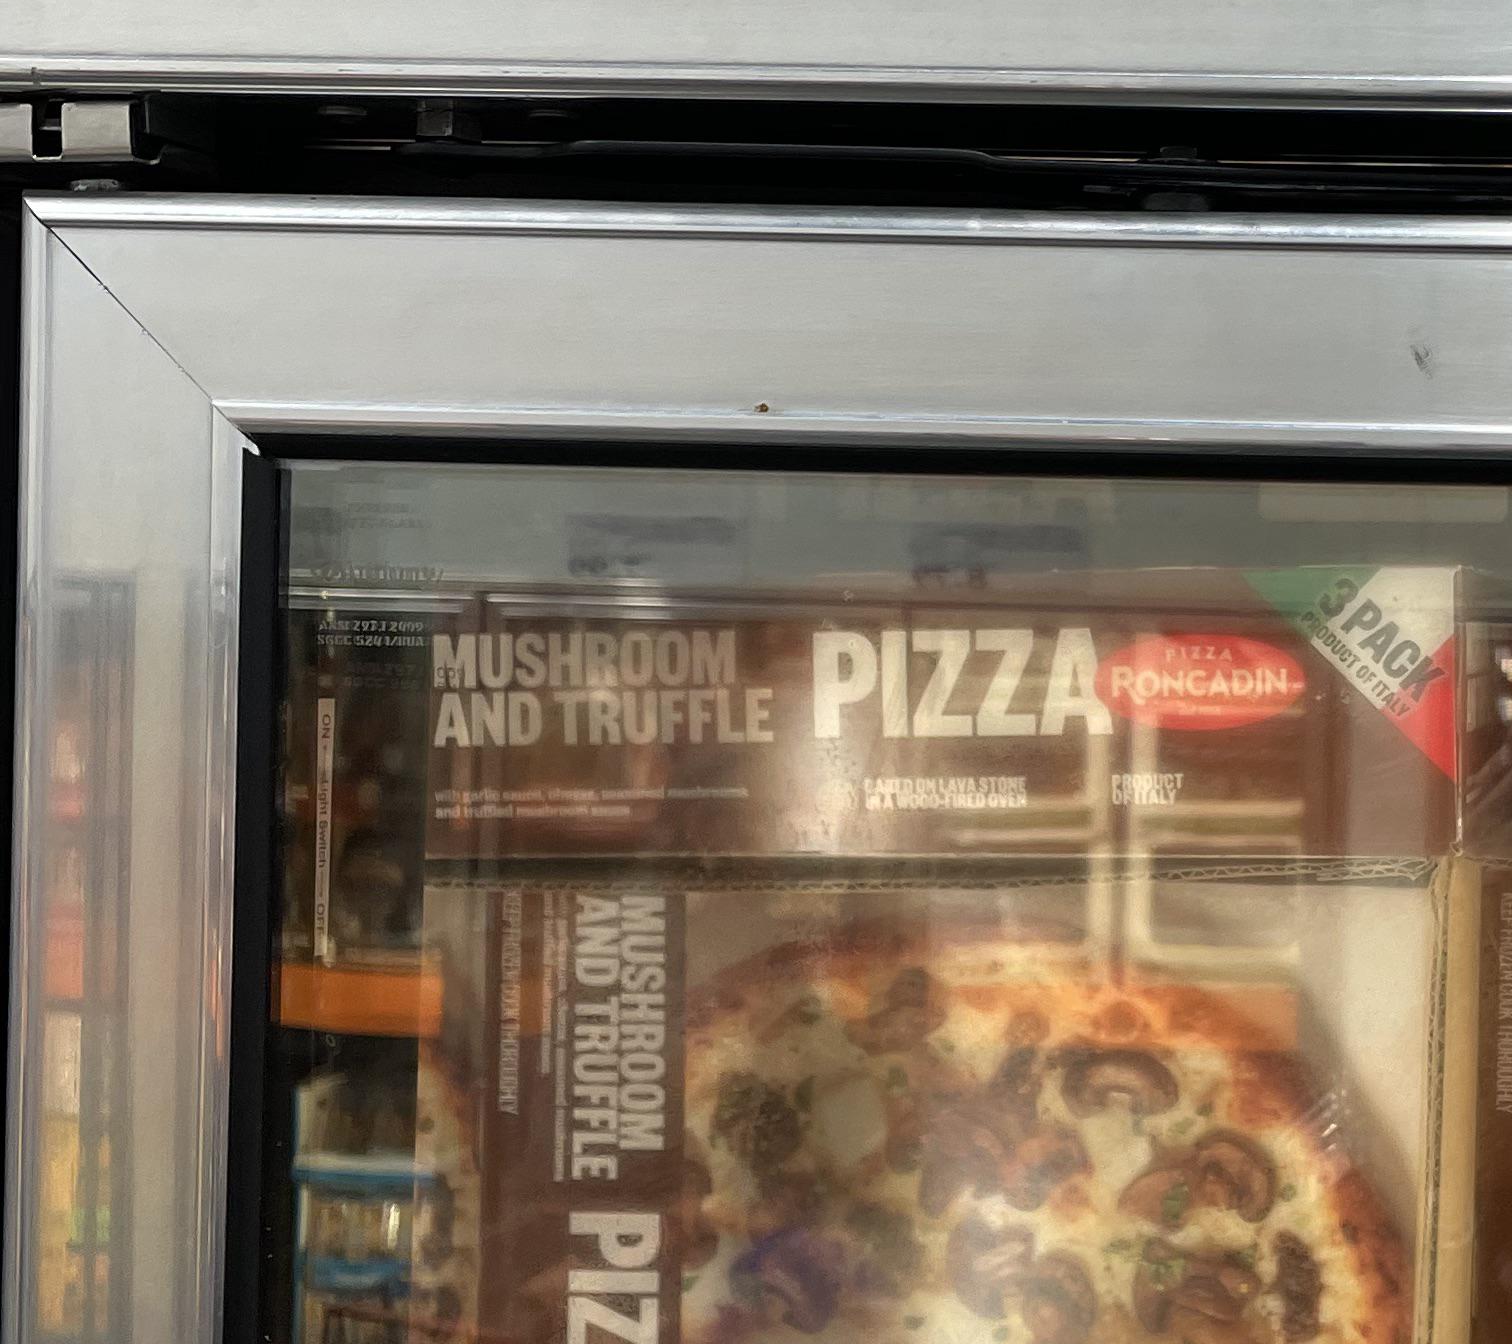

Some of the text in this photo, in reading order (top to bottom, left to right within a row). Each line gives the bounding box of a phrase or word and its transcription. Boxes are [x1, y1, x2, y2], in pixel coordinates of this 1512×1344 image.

[433, 630, 737, 688] MUSHROOM
[1165, 646, 1233, 662] PIZZA
[1301, 611, 1411, 717] PRODUCT OF ITALY
[1319, 578, 1446, 702] 3 PACK
[811, 628, 1114, 738] PIZZA
[1111, 665, 1289, 705] RONCADIN
[320, 713, 330, 739] ON
[434, 688, 774, 747] AND TRUFFLE
[1112, 772, 1185, 790] PRODUCT
[317, 820, 328, 869] Switch
[570, 894, 619, 1180] AND TRUFFLE
[618, 895, 665, 1151] MUSHROOM
